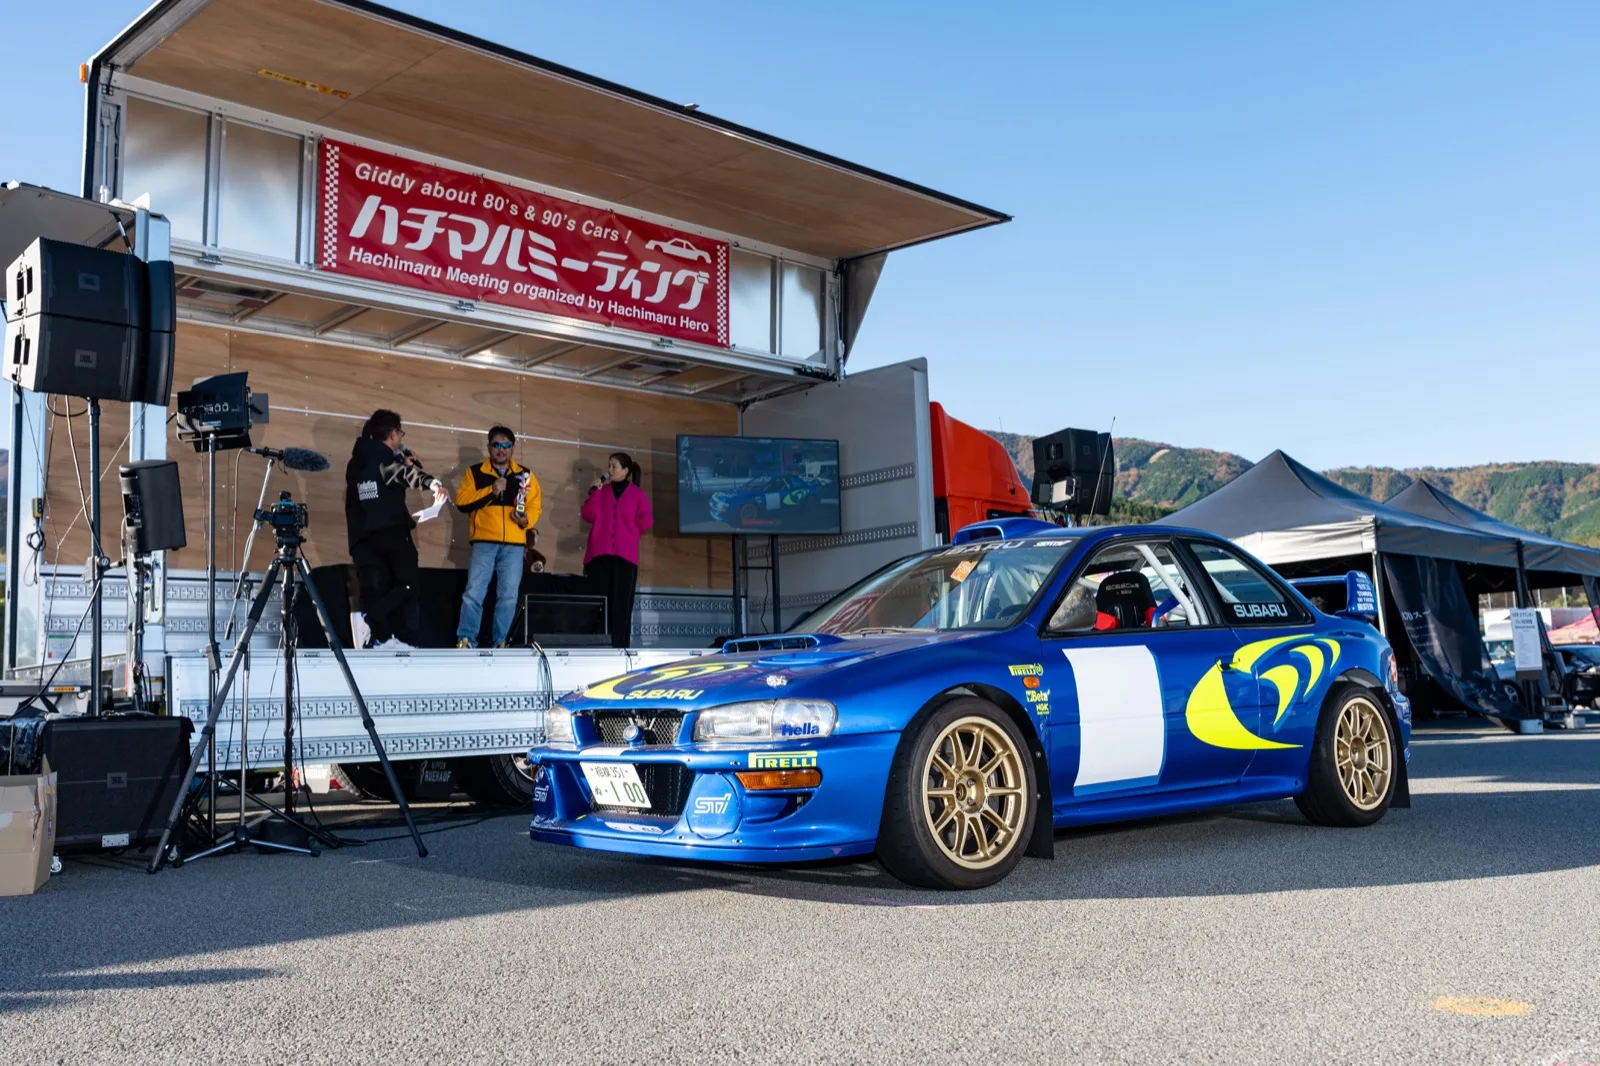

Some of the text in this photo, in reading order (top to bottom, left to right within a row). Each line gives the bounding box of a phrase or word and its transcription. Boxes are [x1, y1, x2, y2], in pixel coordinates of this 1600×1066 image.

[355, 163, 416, 194] Giddy
[420, 181, 478, 206] about
[482, 193, 519, 216] 80's
[524, 205, 536, 221] &
[541, 210, 577, 232] 90's
[582, 220, 619, 242] Cars
[349, 194, 710, 310] ハチマルミーティング
[348, 246, 710, 333] Hachimaru Meeting organized by Hachimaru Hero
[1233, 603, 1288, 618] SUBARU
[625, 689, 704, 700] SUBARU
[781, 722, 820, 736] Hella
[748, 750, 818, 769] PIRELLI
